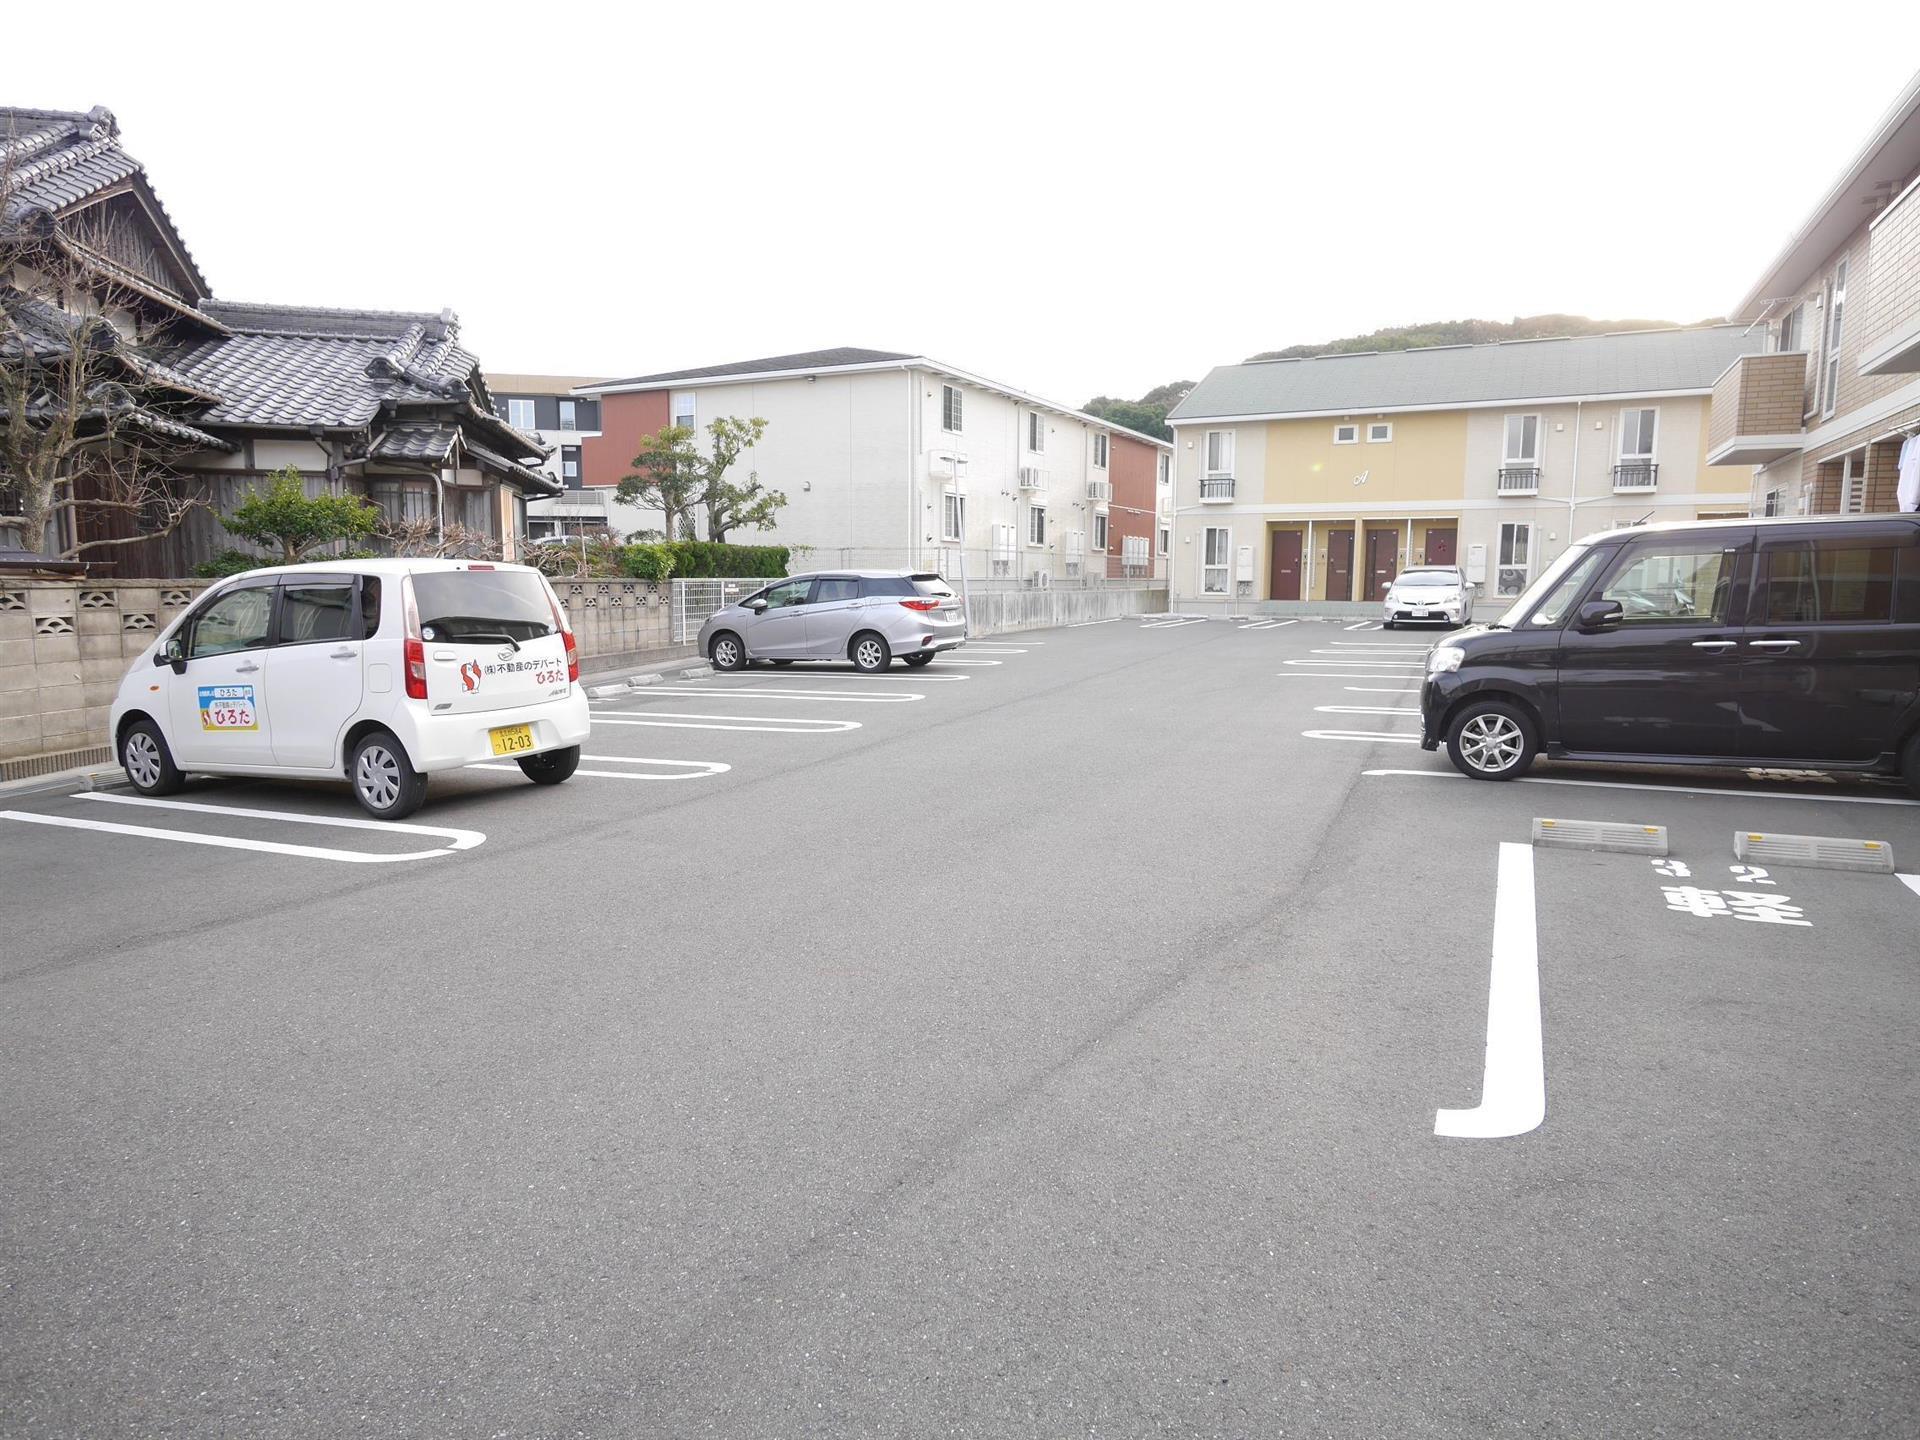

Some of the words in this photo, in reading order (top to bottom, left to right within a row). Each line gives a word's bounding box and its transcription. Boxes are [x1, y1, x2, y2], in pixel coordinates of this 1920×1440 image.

[535, 669, 565, 685] ひろた
[219, 689, 238, 697] ひろた
[214, 709, 250, 725] ひろた
[1660, 886, 1813, 926] 軽
